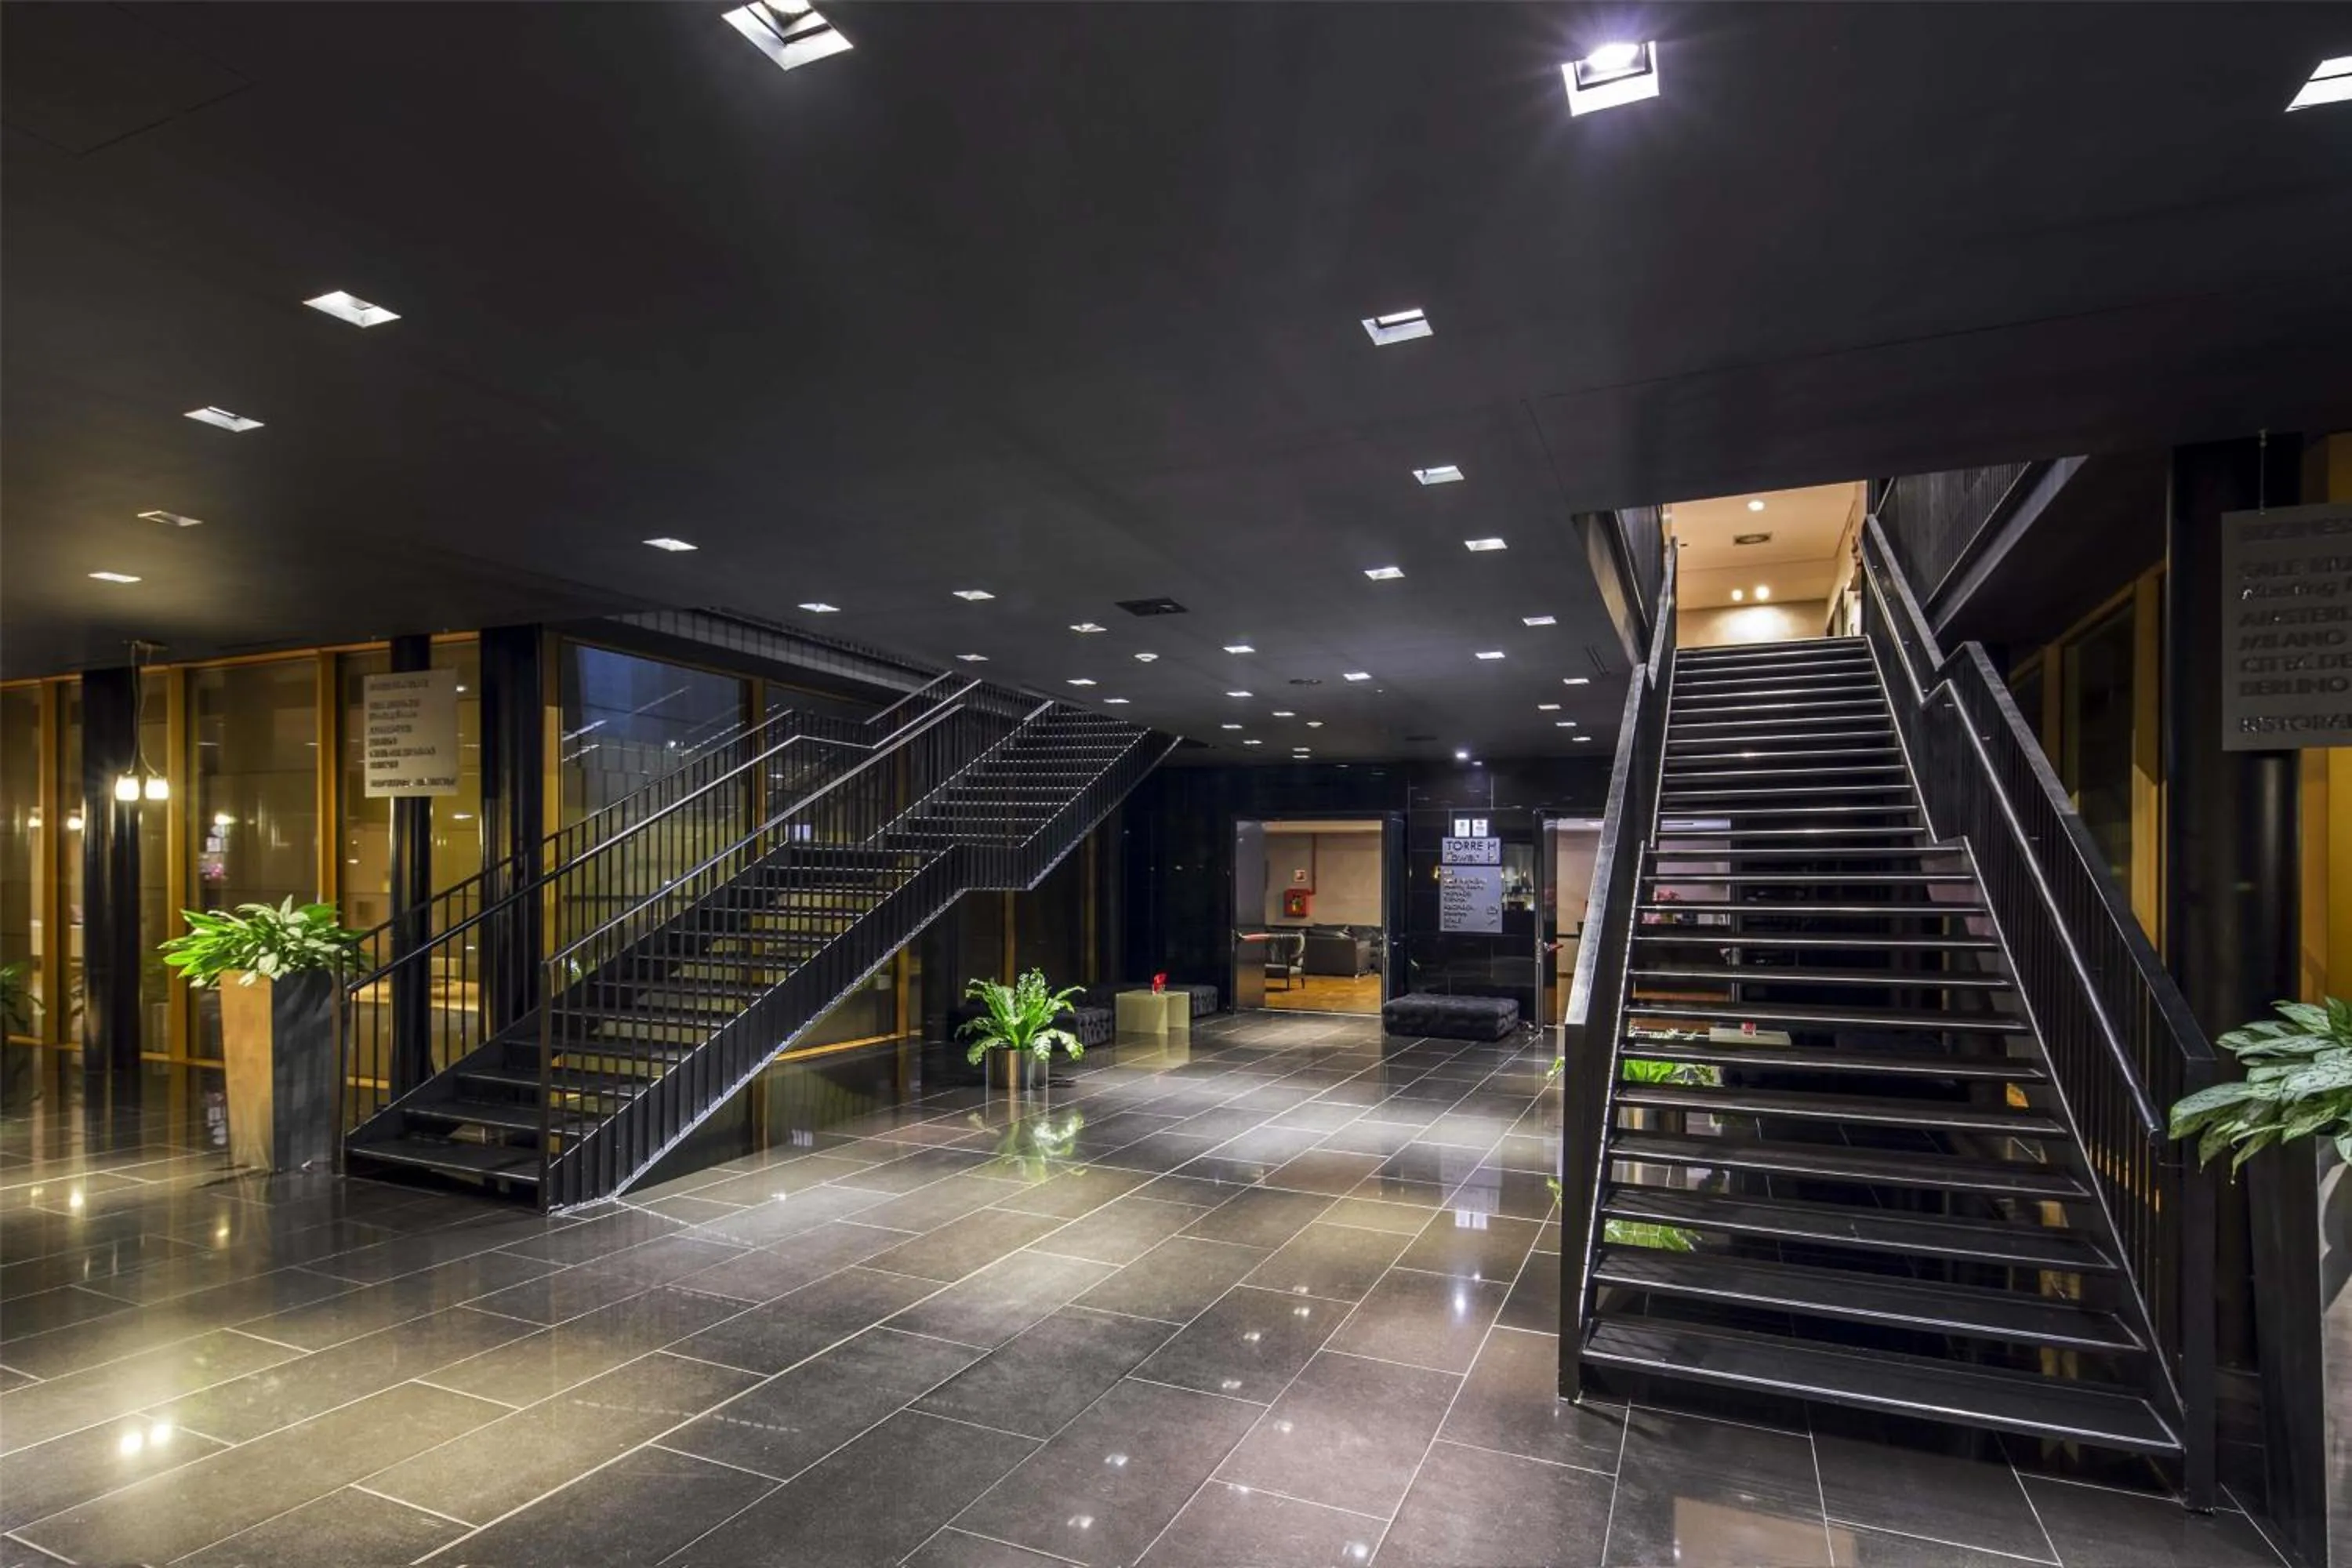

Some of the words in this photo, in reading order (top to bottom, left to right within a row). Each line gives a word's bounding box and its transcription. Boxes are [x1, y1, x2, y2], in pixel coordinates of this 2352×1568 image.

[2238, 630, 2347, 651] MILANO
[2240, 676, 2350, 696] BERLINO
[1446, 840, 1483, 851] TORRE
[1487, 840, 1497, 851] H
